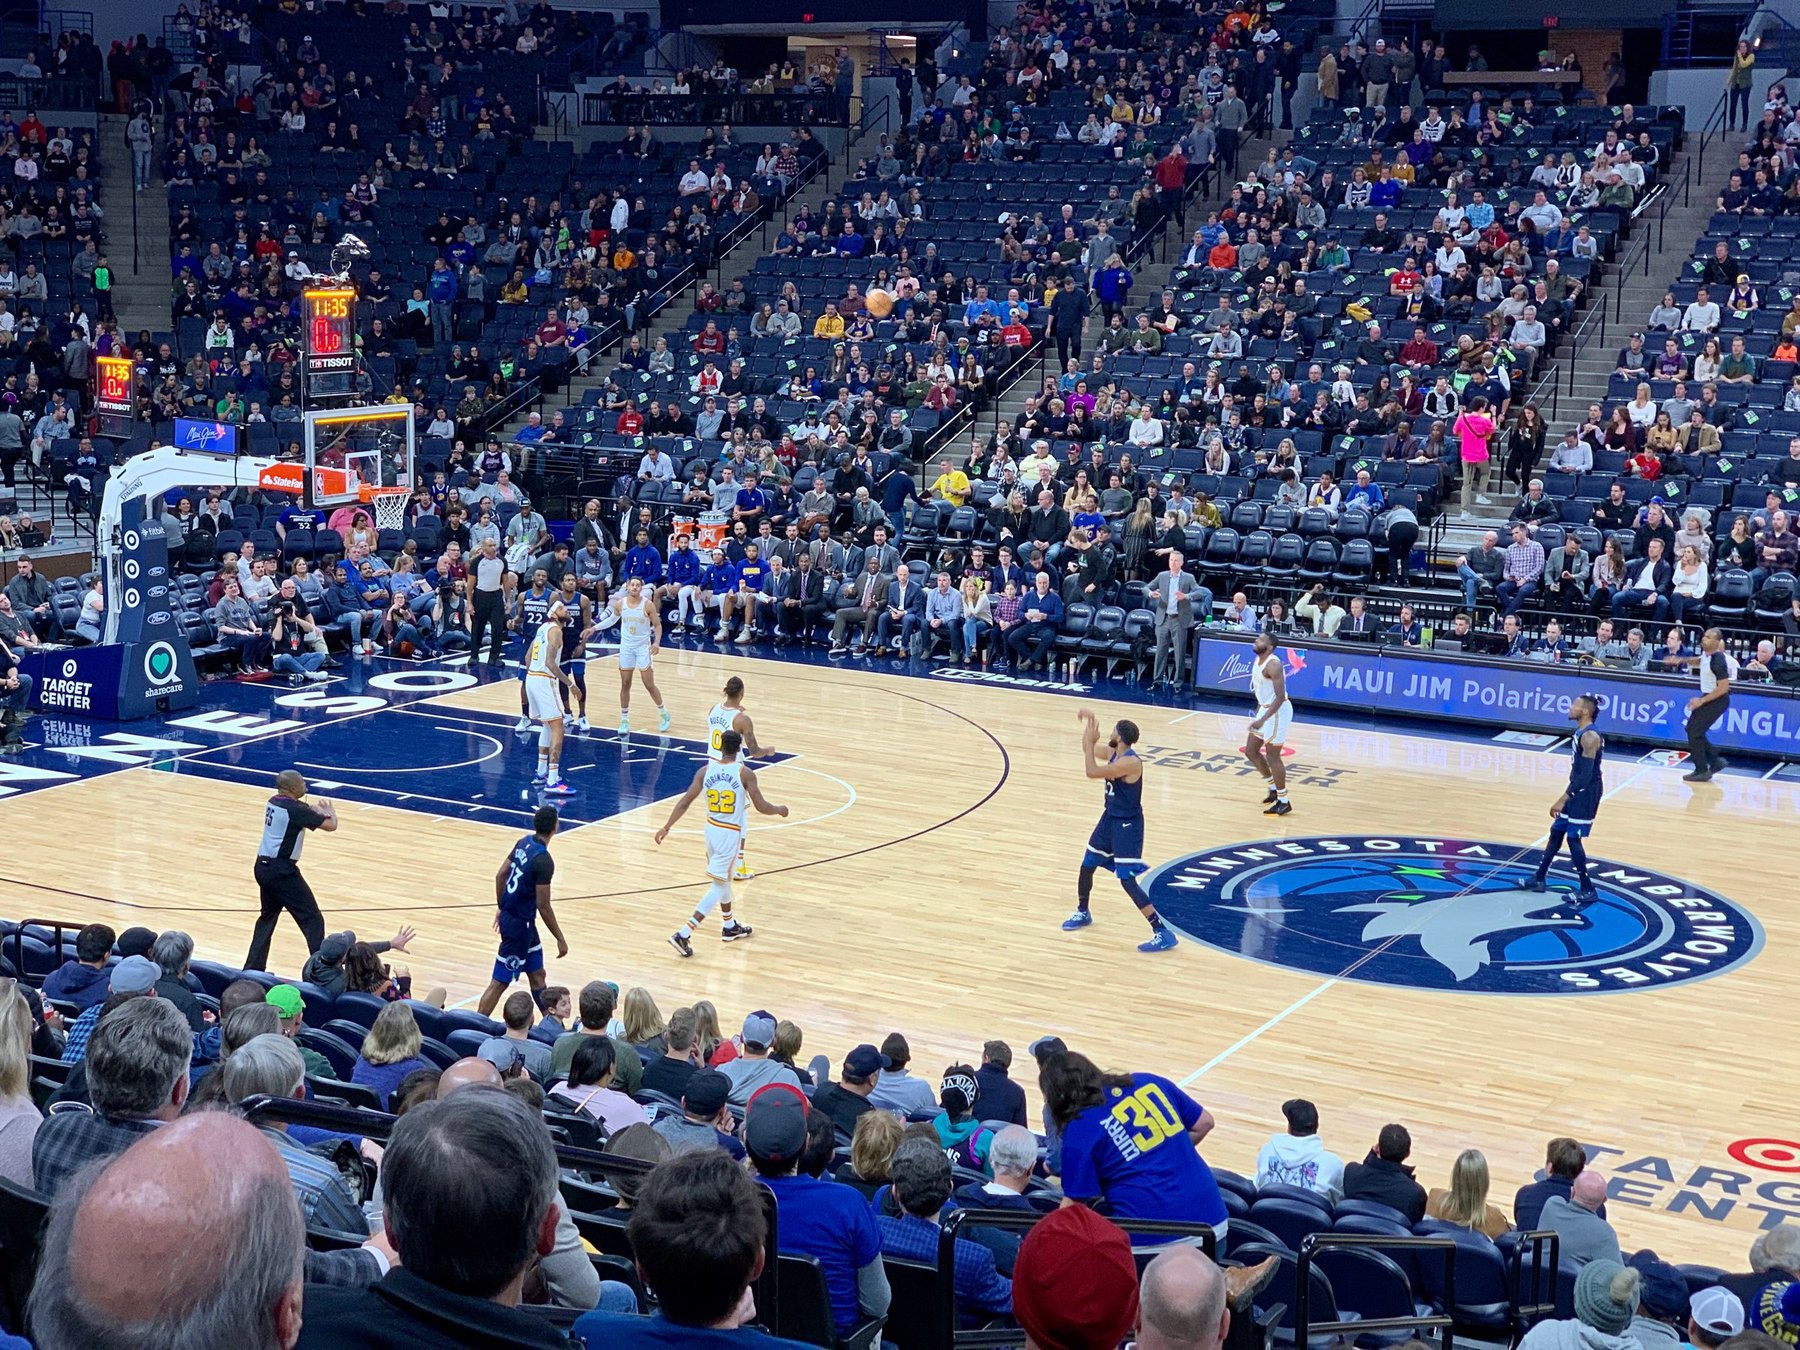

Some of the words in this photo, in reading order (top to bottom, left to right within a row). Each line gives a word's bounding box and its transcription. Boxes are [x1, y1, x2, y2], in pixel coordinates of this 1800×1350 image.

[315, 298, 347, 317] 11:35
[105, 364, 129, 380] 11:35
[322, 357, 353, 368] TISSOT
[120, 479, 143, 500] SPALDING
[148, 527, 165, 535] fitbit
[298, 522, 311, 530] 32
[527, 612, 543, 625] 22
[1218, 653, 1252, 678] Maui
[42, 677, 92, 696] TARGET
[145, 683, 184, 698] sharecare
[1323, 664, 1394, 695] MAUI
[1403, 673, 1452, 701] JIM
[1462, 680, 1591, 714] Polarize
[40, 690, 91, 710] CENTER
[706, 789, 736, 814] 22
[1167, 839, 1491, 889] MINNESOTA
[1111, 1083, 1185, 1153] 30
[1099, 1115, 1141, 1162] CURRY
